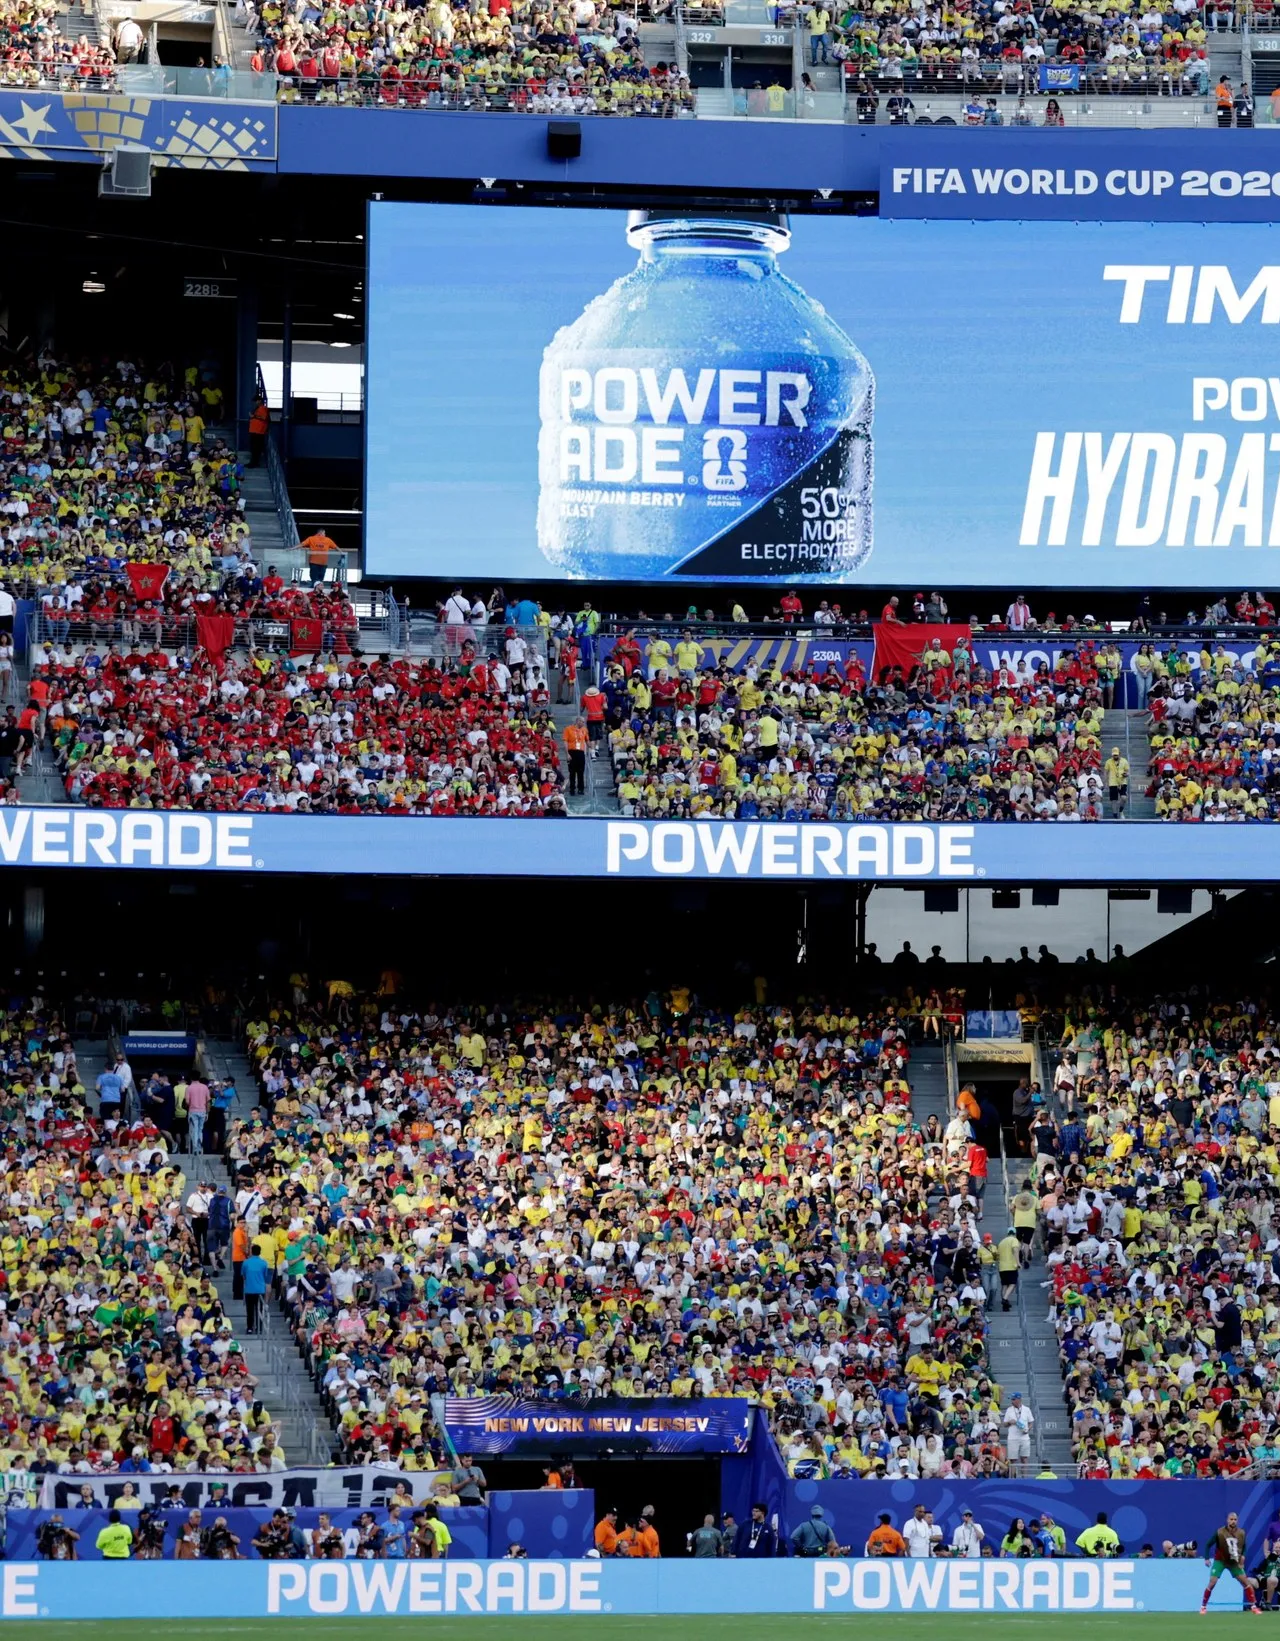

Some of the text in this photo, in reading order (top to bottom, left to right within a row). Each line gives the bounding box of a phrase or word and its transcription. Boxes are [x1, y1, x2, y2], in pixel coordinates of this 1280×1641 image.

[690, 32, 712, 43] 329
[764, 35, 785, 45] 330
[1257, 40, 1278, 50] 330
[893, 167, 967, 194] FIFA
[971, 168, 1099, 195] WORLD
[1105, 169, 1175, 196] CUP
[185, 283, 220, 295] 228B
[560, 366, 813, 429] POWER
[715, 478, 735, 486] FIFA
[560, 488, 686, 508] MOUNTAIN BERRY
[800, 486, 857, 519] 50%
[802, 519, 857, 542] MORE
[267, 627, 284, 635] 229
[812, 651, 842, 662] 230A
[484, 1417, 710, 1432] NEW YORK NEW JERSEY
